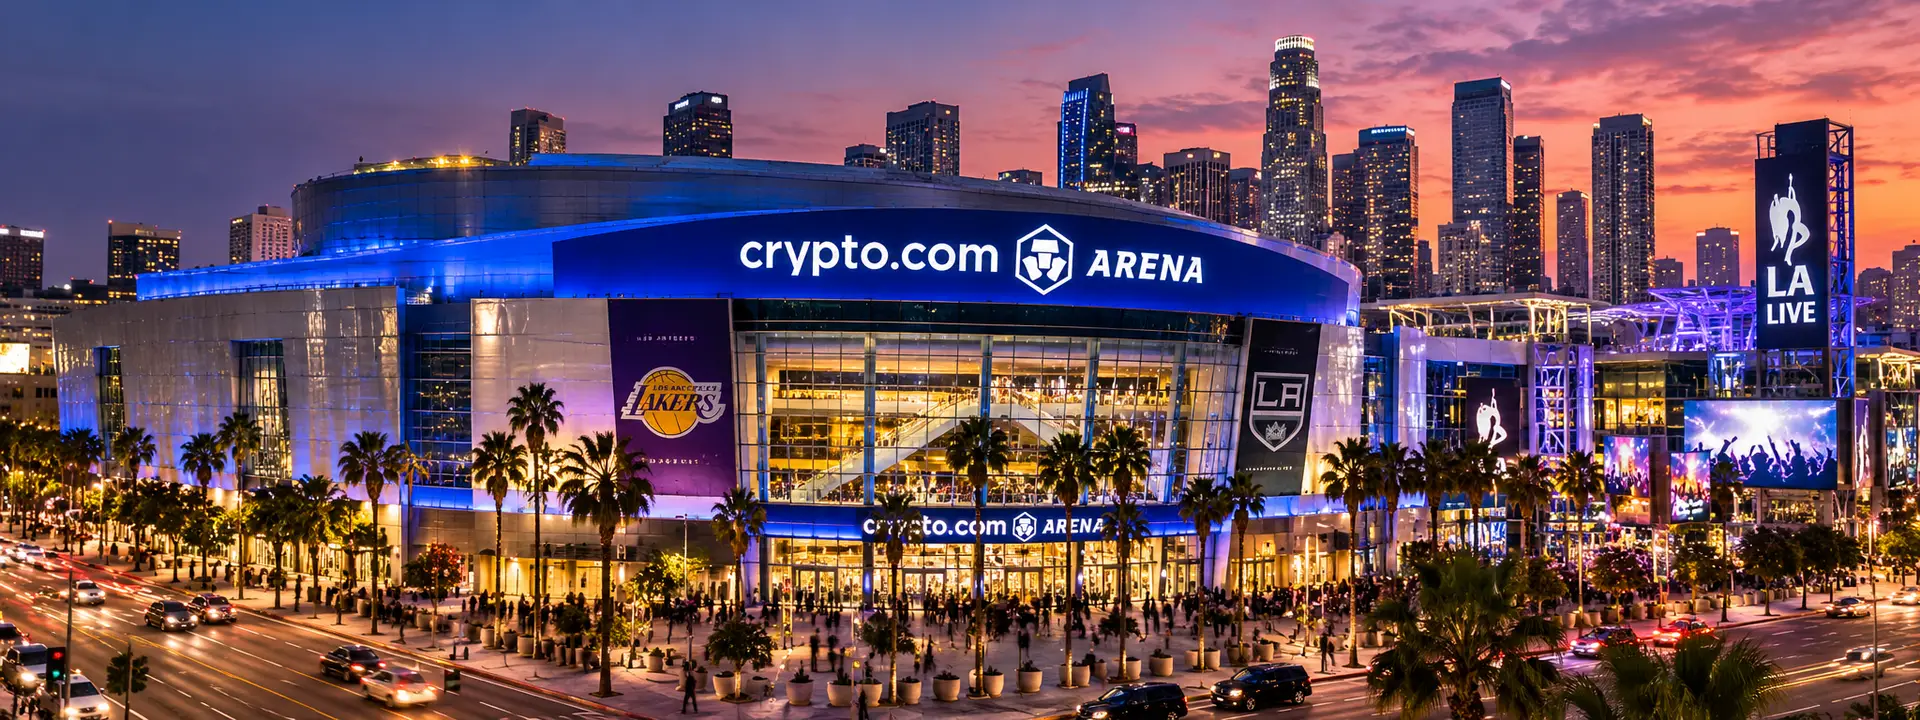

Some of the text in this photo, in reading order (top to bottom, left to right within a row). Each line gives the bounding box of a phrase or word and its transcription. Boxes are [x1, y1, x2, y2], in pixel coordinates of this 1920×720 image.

[739, 234, 1204, 285] crypto.com ARENA
[1767, 265, 1815, 298] LA
[1767, 300, 1816, 325] LIVE
[625, 385, 721, 420] LAKERS
[1256, 381, 1303, 408] LA
[1042, 518, 1104, 534] ARENA
